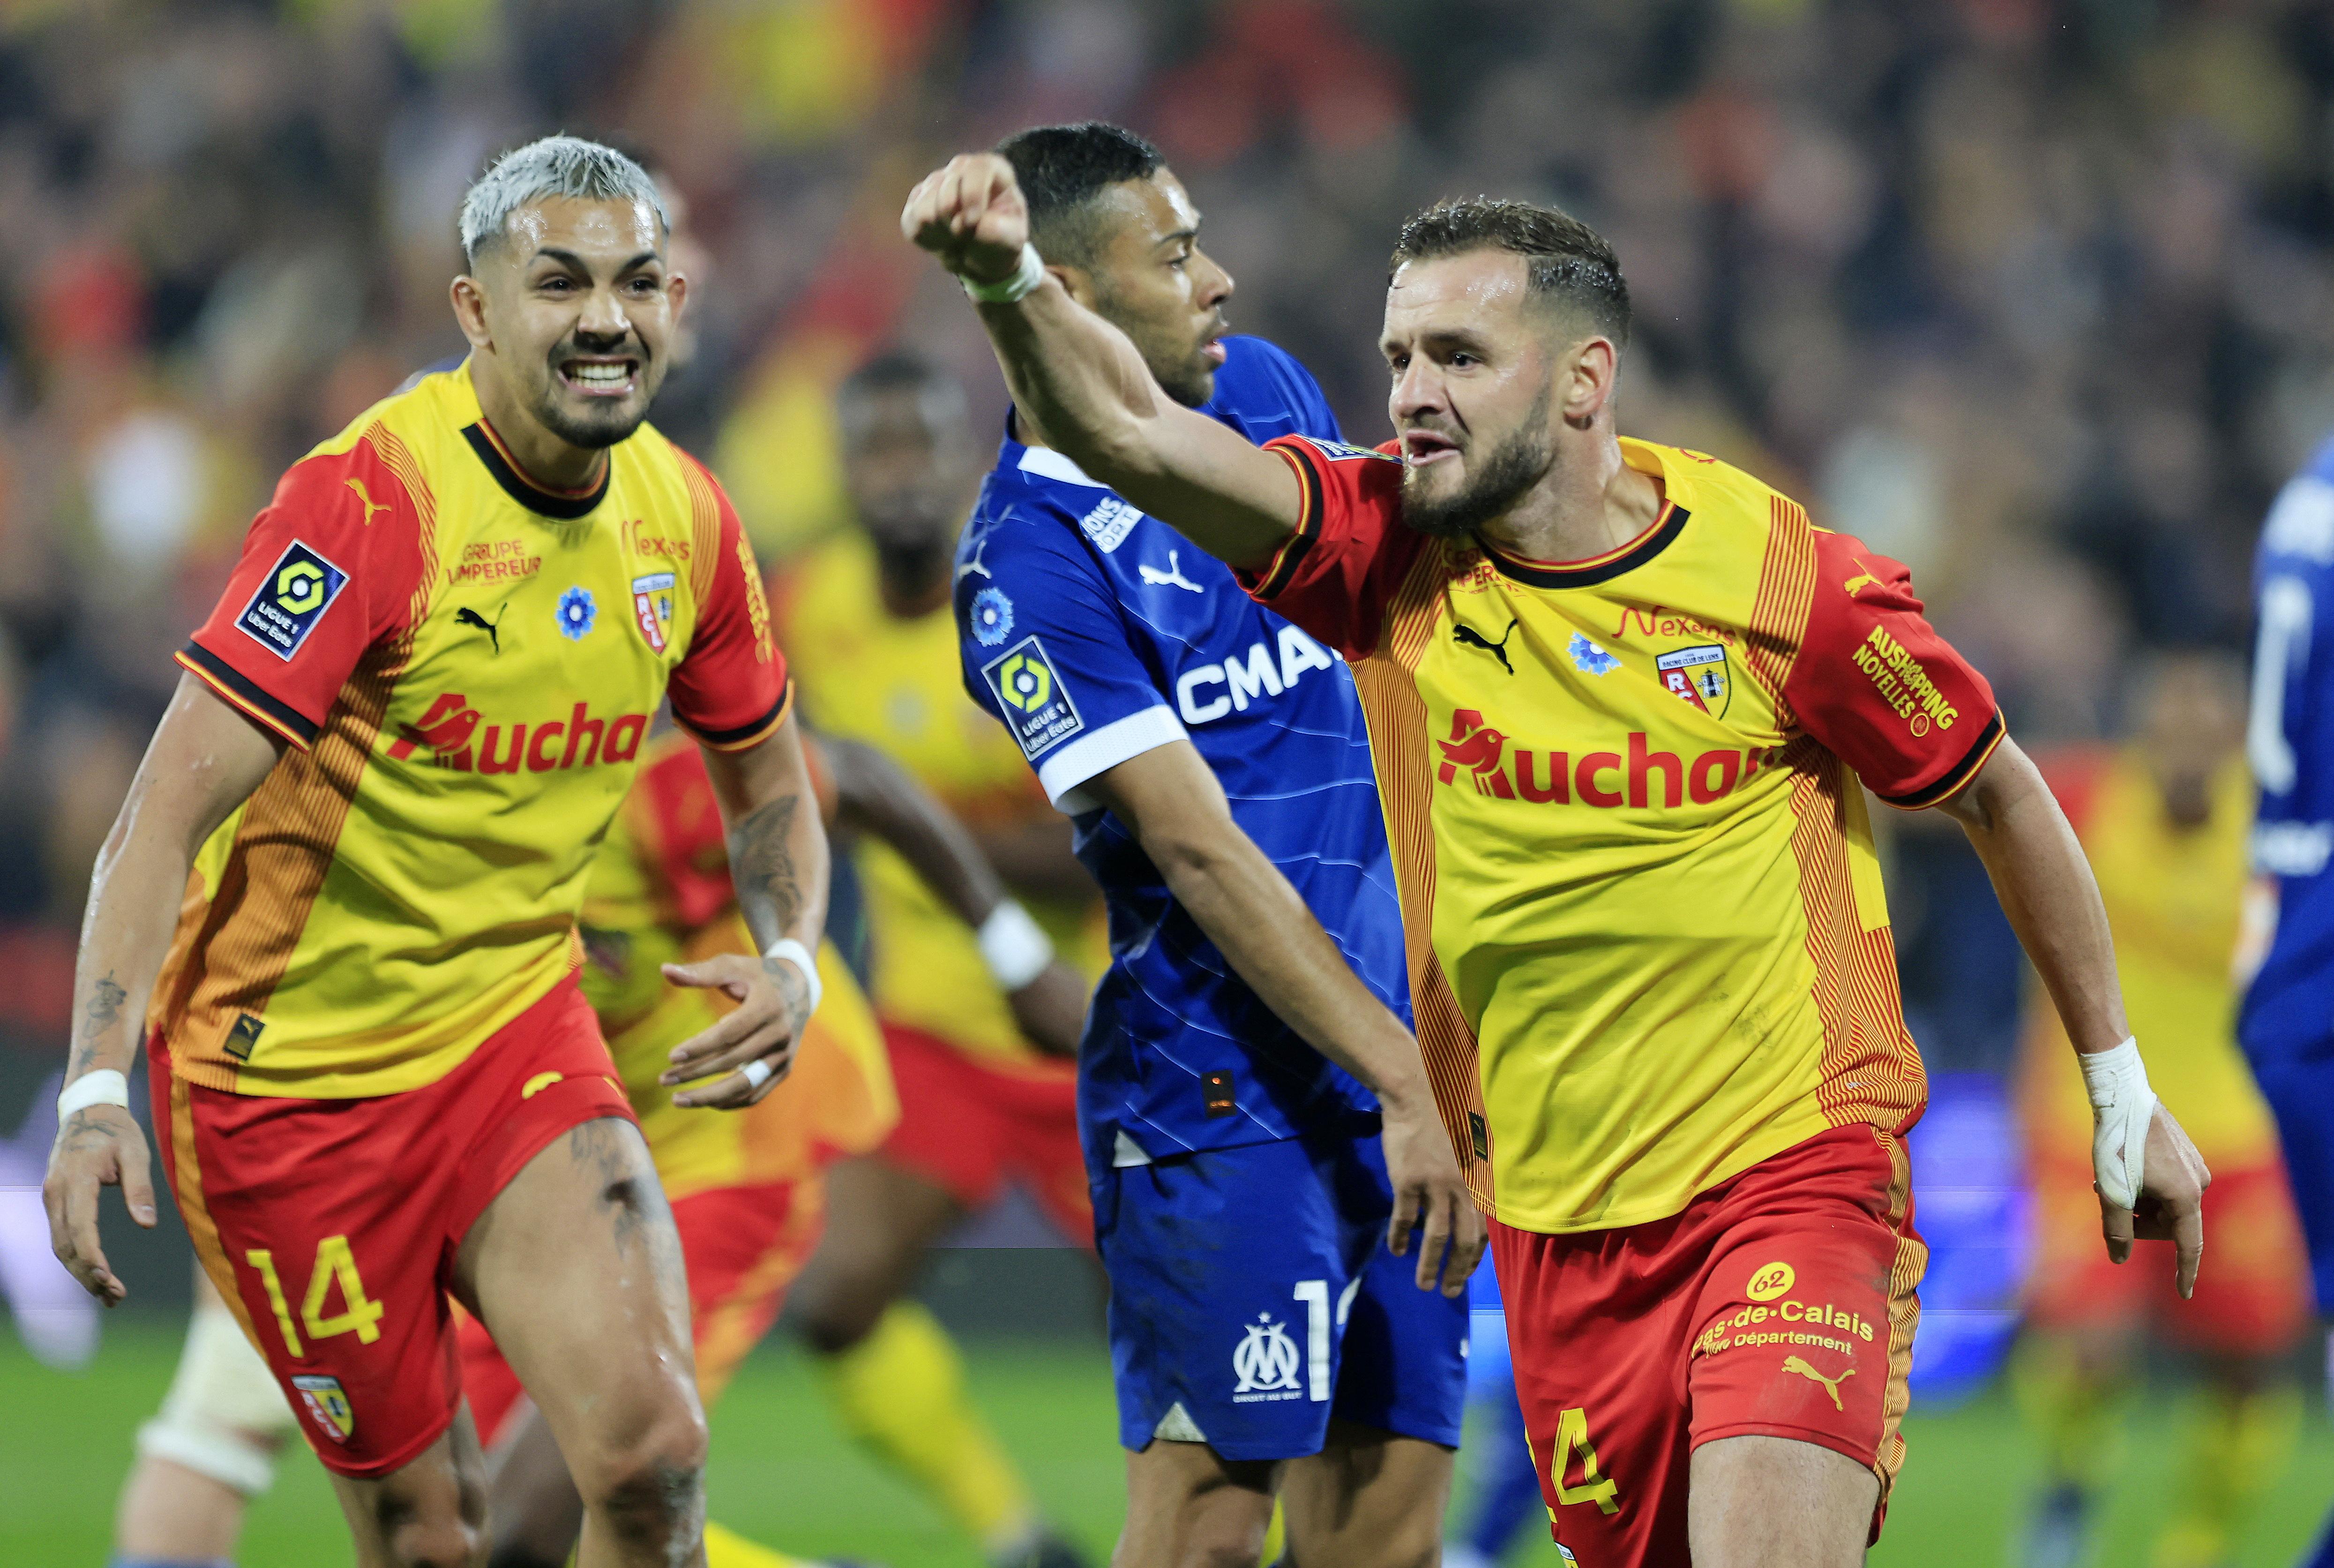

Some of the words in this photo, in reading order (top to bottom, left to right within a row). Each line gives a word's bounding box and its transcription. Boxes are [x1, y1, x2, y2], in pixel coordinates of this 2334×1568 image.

[463, 539, 525, 562] GROUPE
[247, 610, 271, 632] Uber
[268, 624, 293, 648] Eats
[258, 601, 293, 630] LIGUE
[291, 623, 299, 635] 1
[1611, 605, 1736, 647] Nexans
[1176, 625, 1333, 724] CMA
[1852, 644, 1916, 719] NOYELLES
[1867, 625, 1958, 730] AUSHOPPING
[385, 693, 647, 775] Aucha
[1022, 707, 1058, 737] LIGUE
[1055, 702, 1066, 714] 1
[1025, 732, 1050, 752] Uber
[1047, 715, 1077, 738] Eats
[246, 1234, 385, 1359] 14
[1753, 1270, 1785, 1294] 62
[1293, 1276, 1362, 1402] 1
[1734, 1331, 1853, 1356] Département
